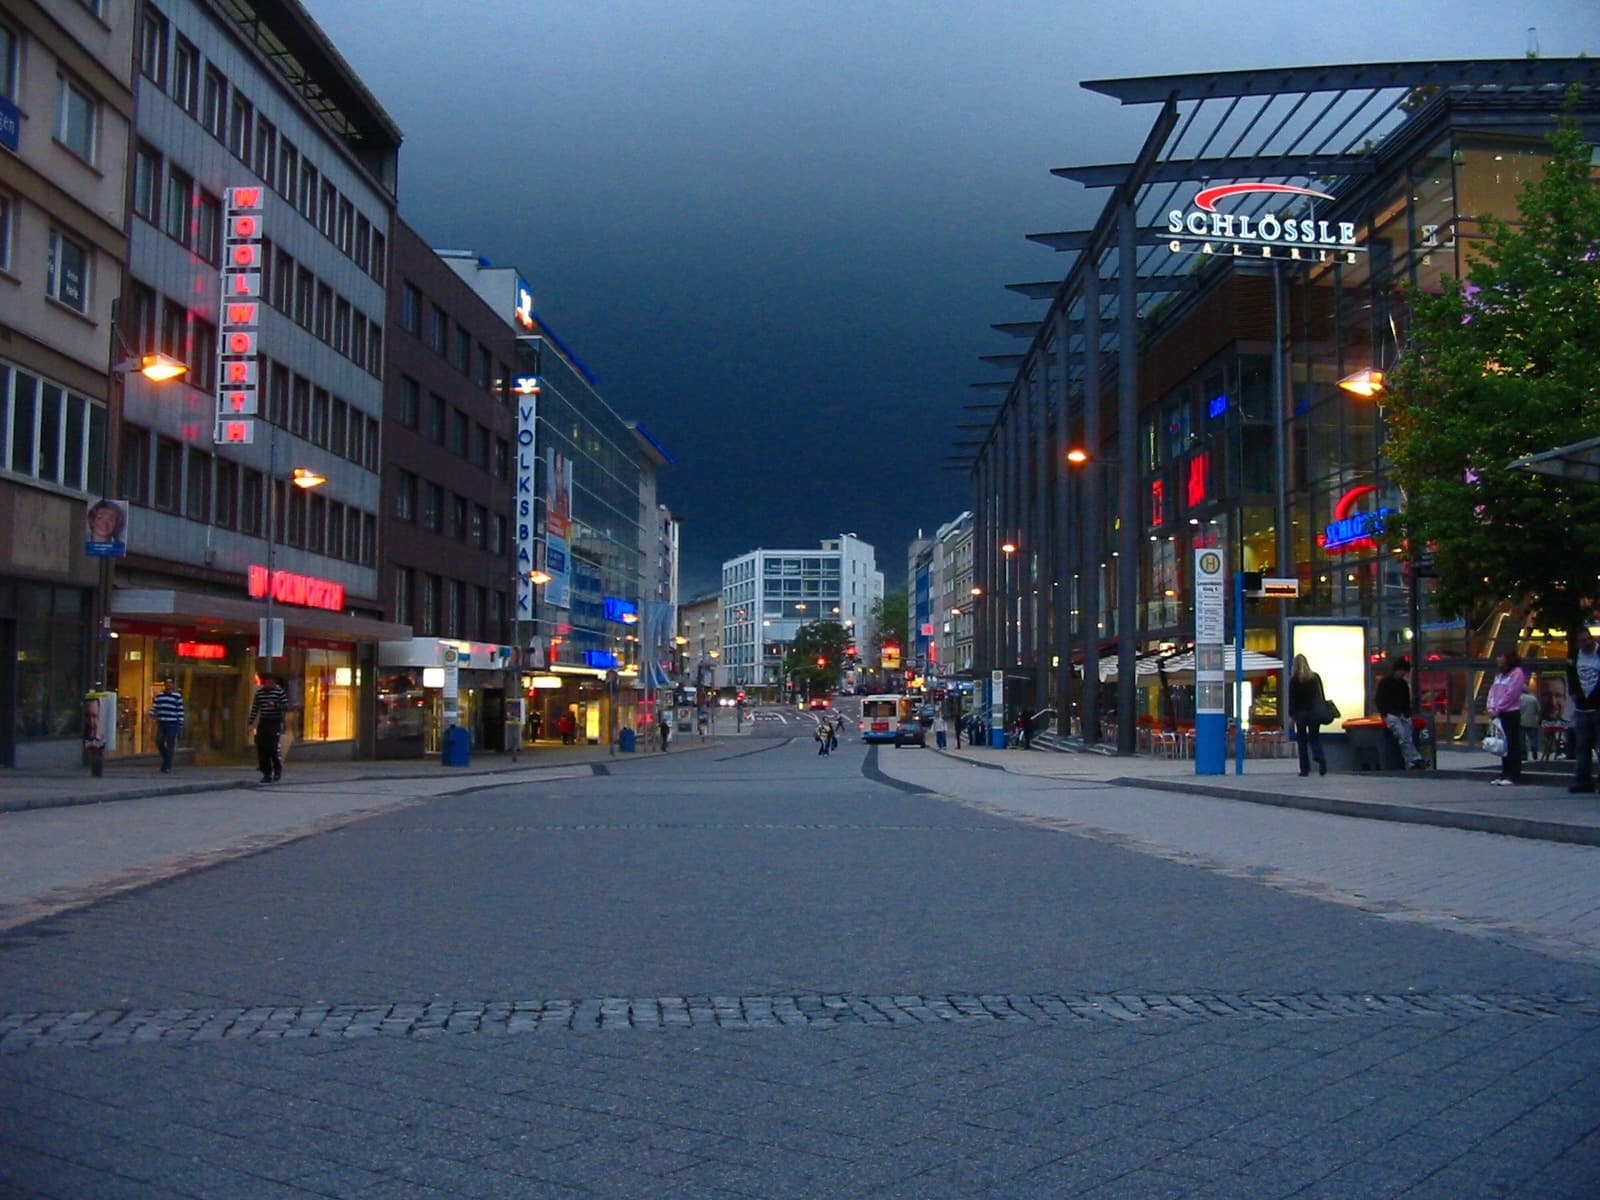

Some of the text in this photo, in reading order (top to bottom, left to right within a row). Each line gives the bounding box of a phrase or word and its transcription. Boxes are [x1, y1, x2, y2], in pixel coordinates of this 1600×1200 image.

[1168, 210, 1356, 244] SCHLÖSSLE
[1169, 240, 1356, 264] GALERIE
[227, 187, 260, 441] WOOLWORTH
[518, 406, 534, 611] VOLKSBANK
